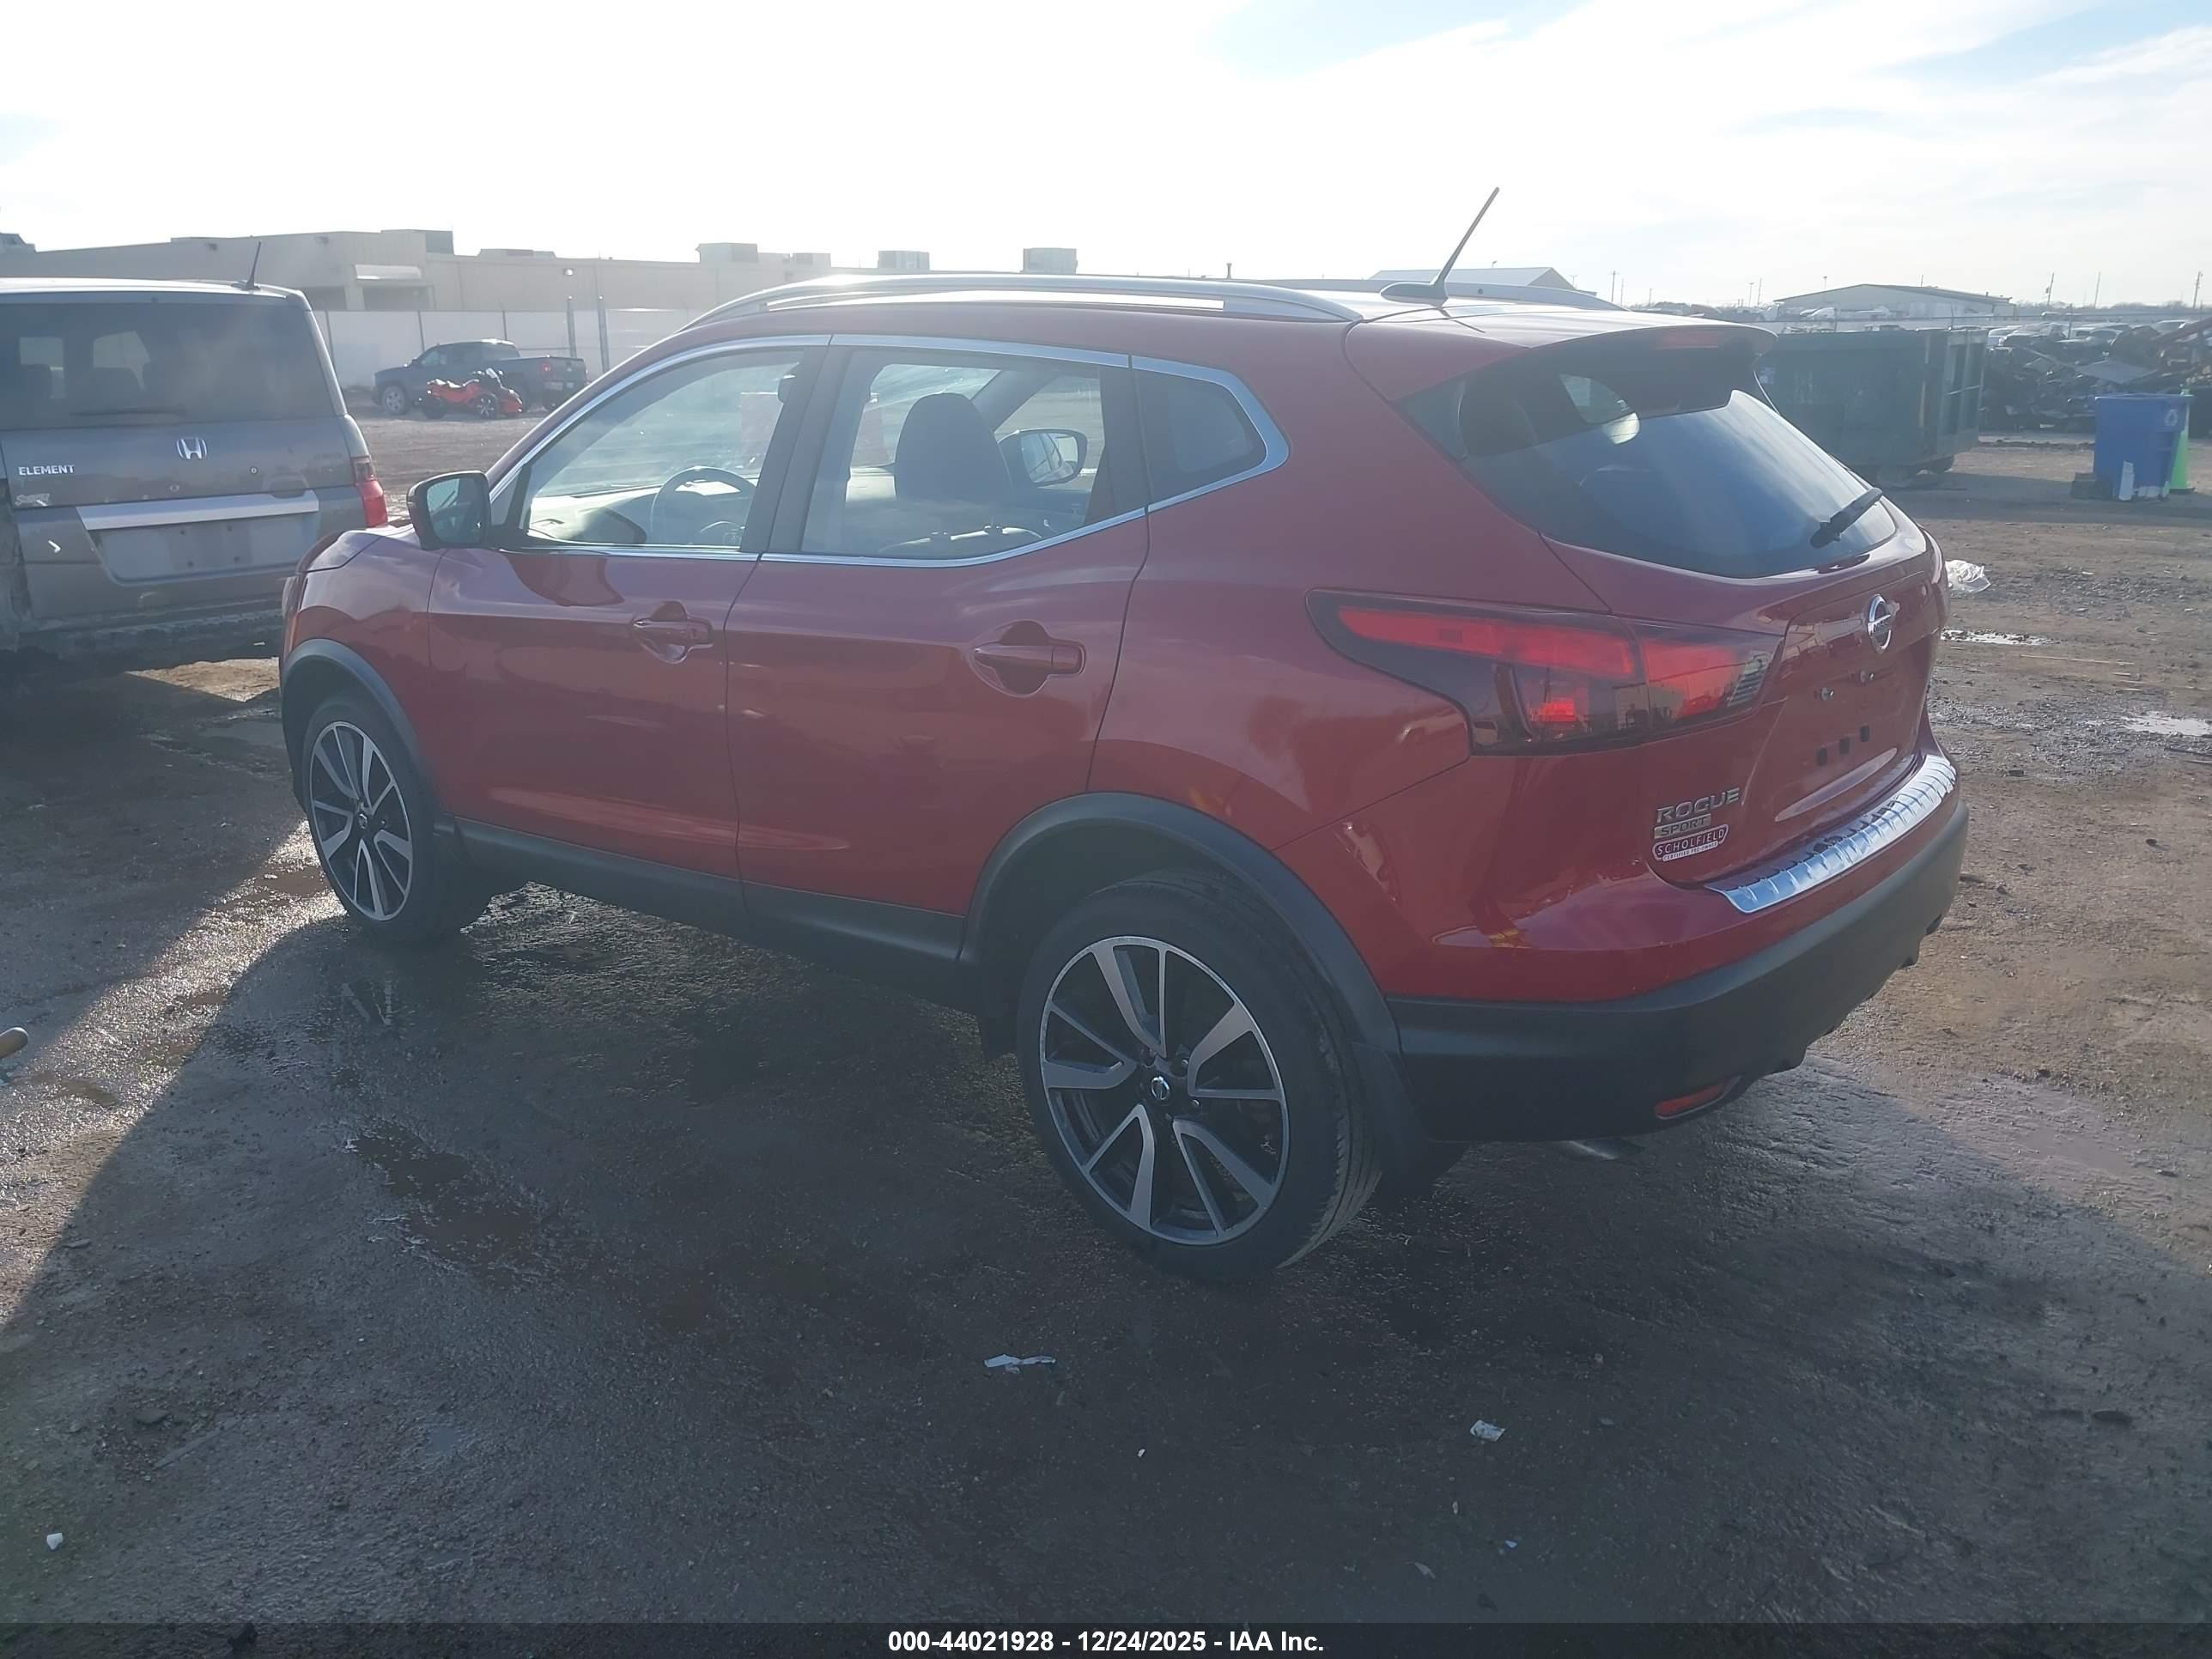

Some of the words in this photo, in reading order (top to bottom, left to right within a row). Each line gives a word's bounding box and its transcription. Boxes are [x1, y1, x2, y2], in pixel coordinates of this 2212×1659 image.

[18, 465, 75, 476] ELEMENT
[1656, 787, 1740, 823] ROGUE
[1661, 817, 1707, 836] SPORT
[1657, 829, 1725, 855] SCHOLFIELD
